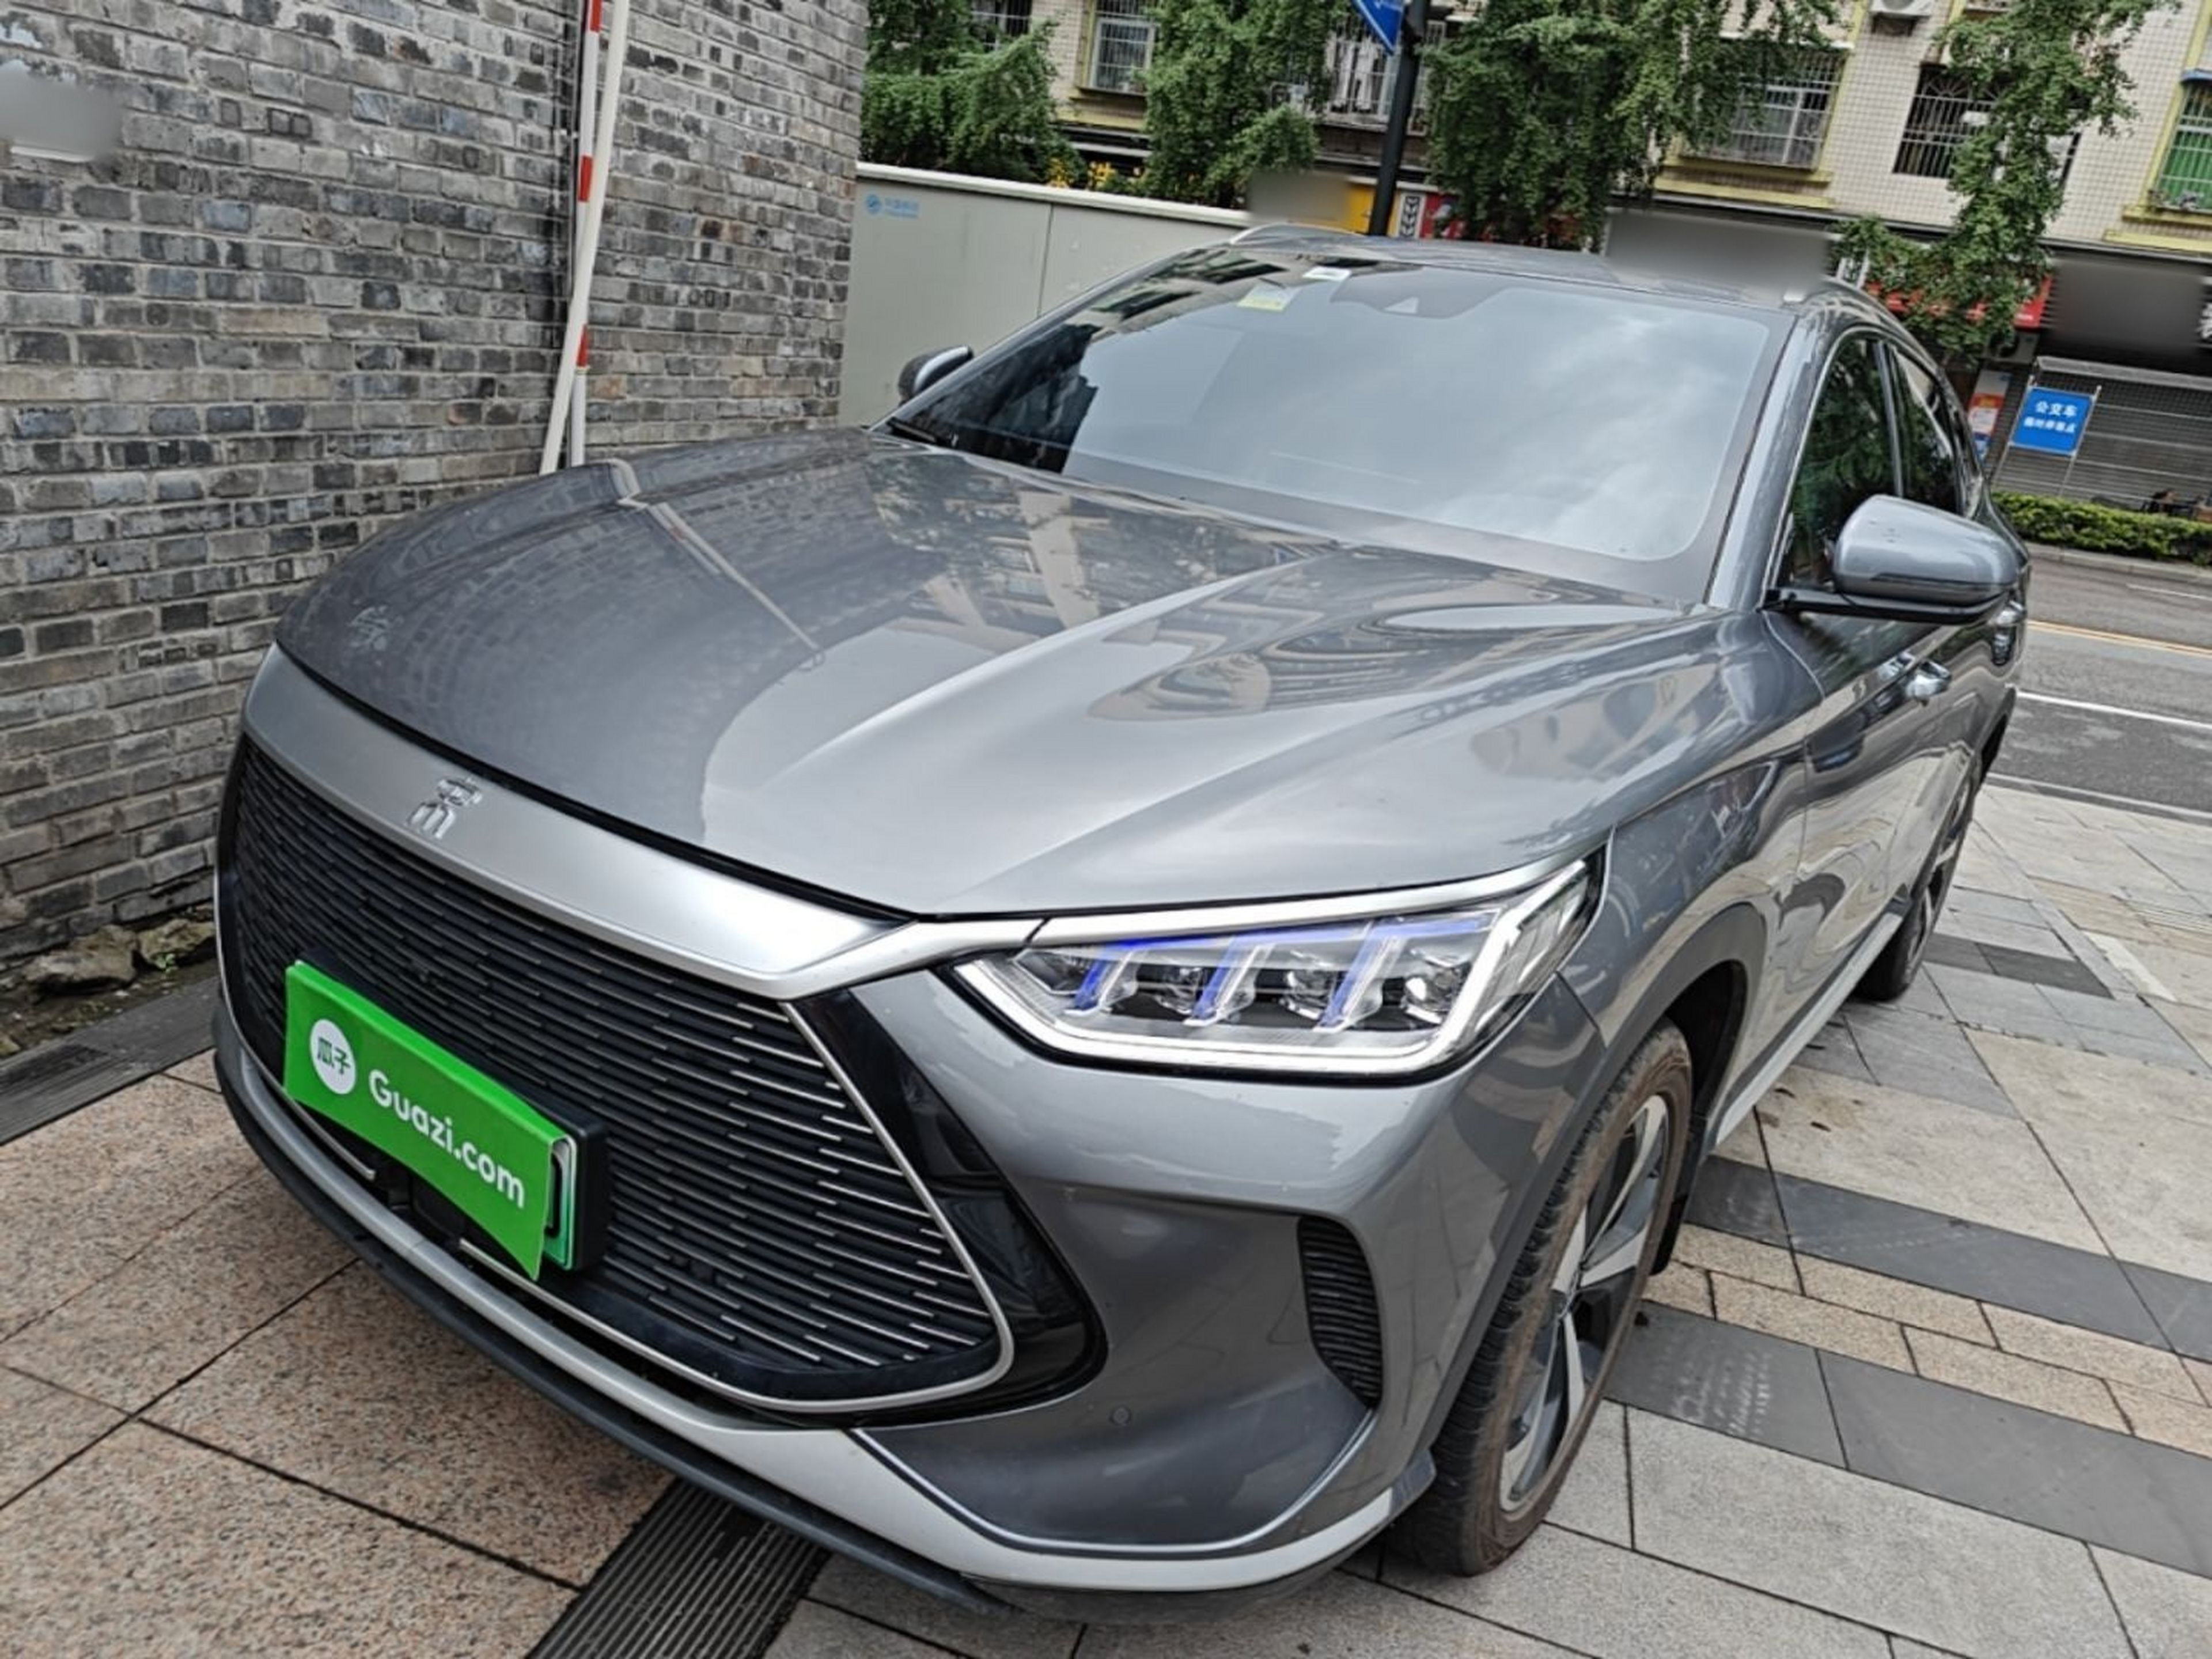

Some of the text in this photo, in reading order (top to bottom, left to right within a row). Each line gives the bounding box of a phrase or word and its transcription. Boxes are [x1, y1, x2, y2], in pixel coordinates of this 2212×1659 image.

[2035, 400, 2077, 417] 公交车
[317, 1036, 351, 1075] 瓜子
[368, 1070, 525, 1209] Guazi.com
